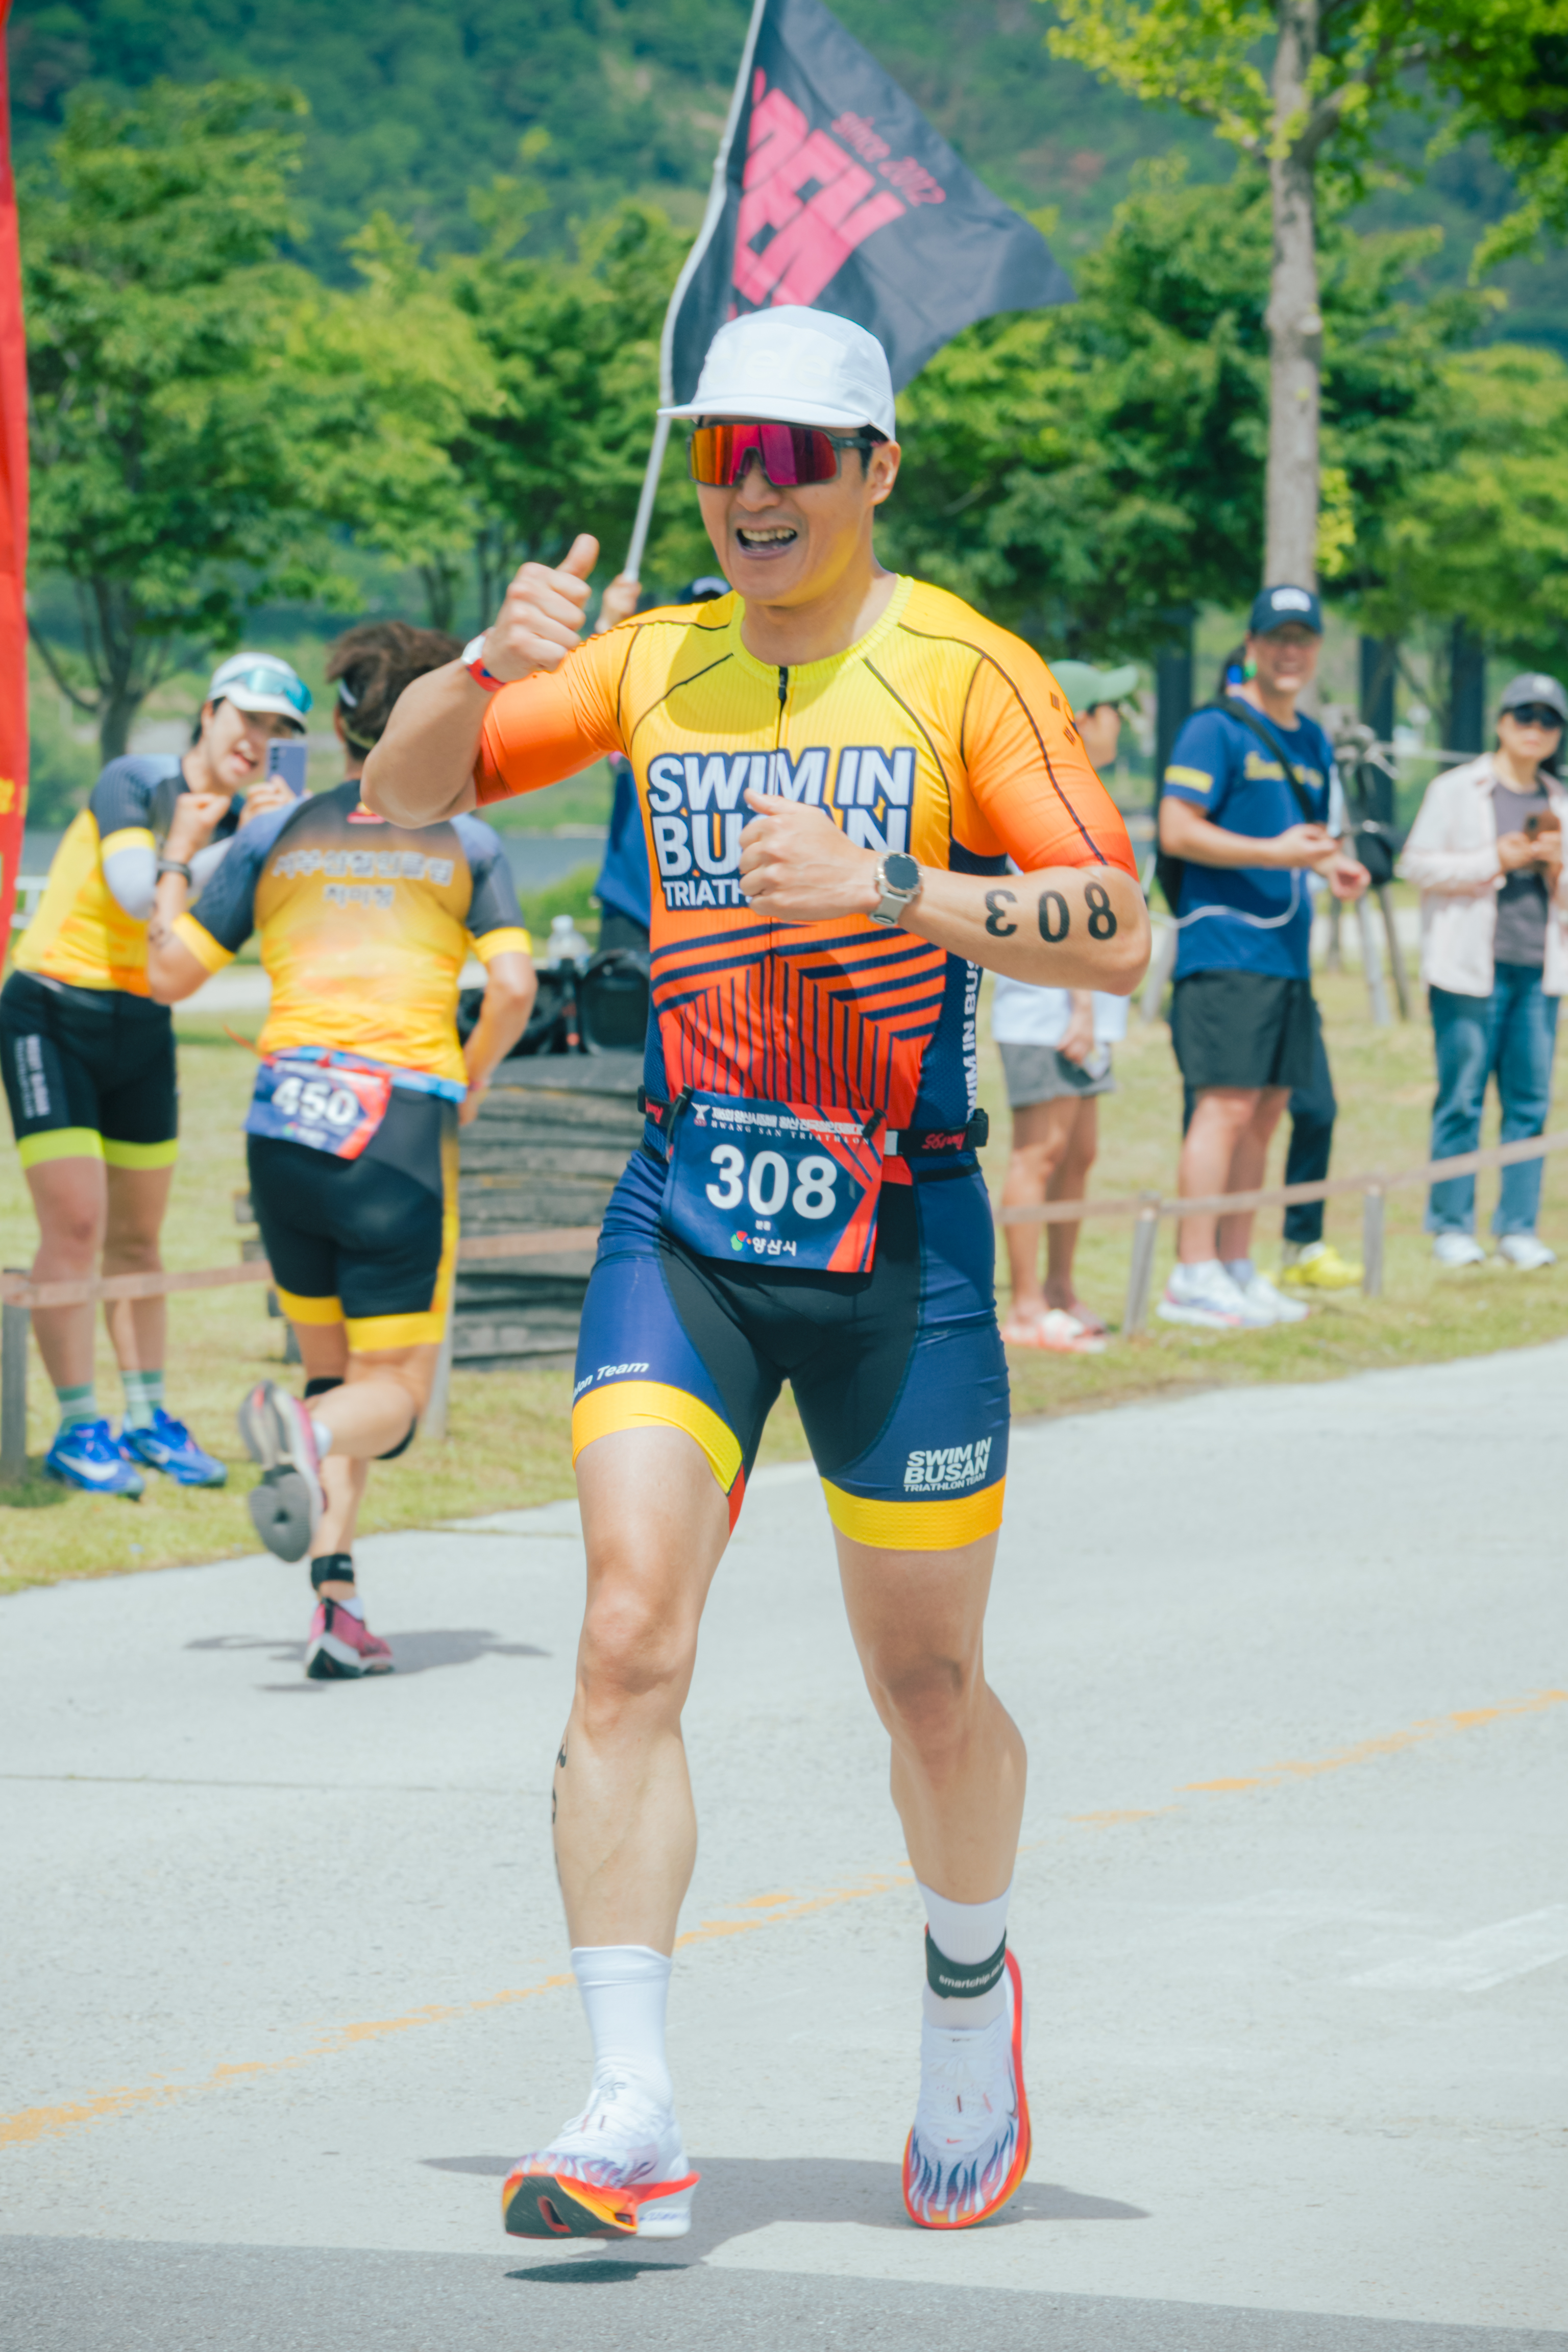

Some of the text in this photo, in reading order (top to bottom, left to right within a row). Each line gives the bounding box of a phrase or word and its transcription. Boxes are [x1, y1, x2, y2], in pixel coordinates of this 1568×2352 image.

[648, 749, 912, 813] SWIM IN
[651, 807, 908, 876] BUN
[663, 878, 753, 907] TRIATH
[963, 1020, 976, 1051] IN
[272, 1076, 359, 1124] 450
[711, 1120, 869, 1145] HWANG SAN TRIATHLON
[705, 1144, 837, 1219] 308
[752, 1237, 797, 1257] 양산시
[597, 1362, 649, 1380] Team
[907, 1436, 992, 1467] SWIM IN
[903, 1453, 989, 1484] BUSAN
[903, 1472, 986, 1492] TRIATHLON TEAM
